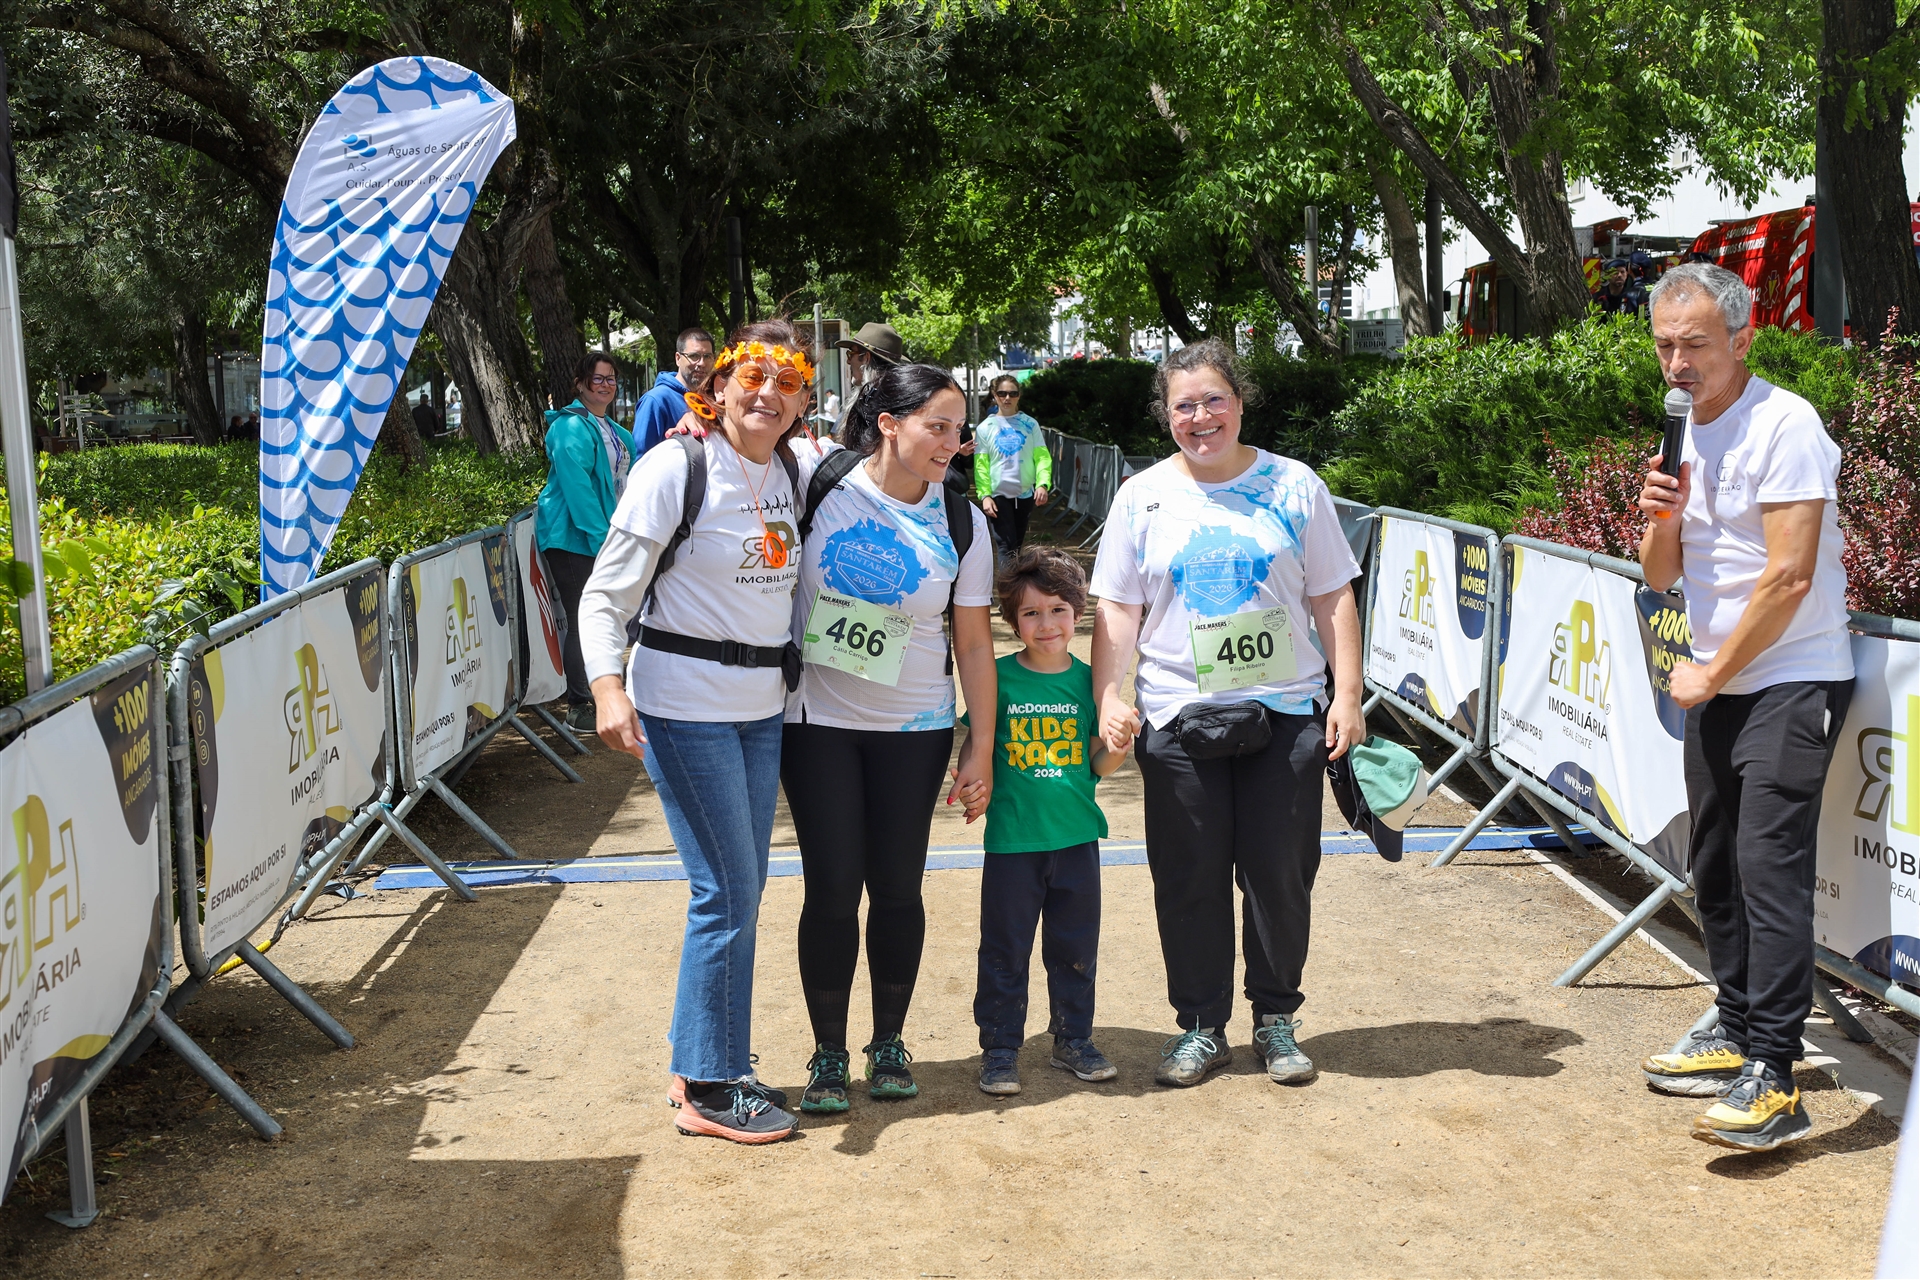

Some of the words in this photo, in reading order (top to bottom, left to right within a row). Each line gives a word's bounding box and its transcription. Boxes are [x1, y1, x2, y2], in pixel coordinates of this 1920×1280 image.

[388, 144, 420, 158] Águas
[424, 144, 437, 154] de
[347, 162, 371, 171] A.S.
[1355, 341, 1386, 349] PERDIDO
[1356, 330, 1384, 339] TRILHO
[841, 550, 898, 579] SANTARÉM
[1463, 544, 1487, 572] +1000
[1461, 570, 1486, 596] IMÓVEIS
[826, 617, 887, 657] 466
[1217, 631, 1274, 665] 460
[1230, 665, 1245, 673] Filipa
[1246, 662, 1266, 670] Ribeiro
[1007, 703, 1078, 715] McDonald's
[1548, 696, 1608, 742] IMOBILIÁRIA
[1010, 717, 1077, 741] KIDS
[1529, 723, 1538, 738] POR
[1562, 725, 1574, 740] REAL
[1575, 732, 1593, 750] ESTATE
[1004, 740, 1083, 771] RACE
[1034, 768, 1062, 778] 2024
[211, 873, 249, 911] ESTAMOS
[249, 860, 267, 885] AQUI
[267, 848, 280, 871] POR
[280, 843, 287, 859] SI
[1830, 882, 1840, 900] SI
[1890, 881, 1917, 904] REAL
